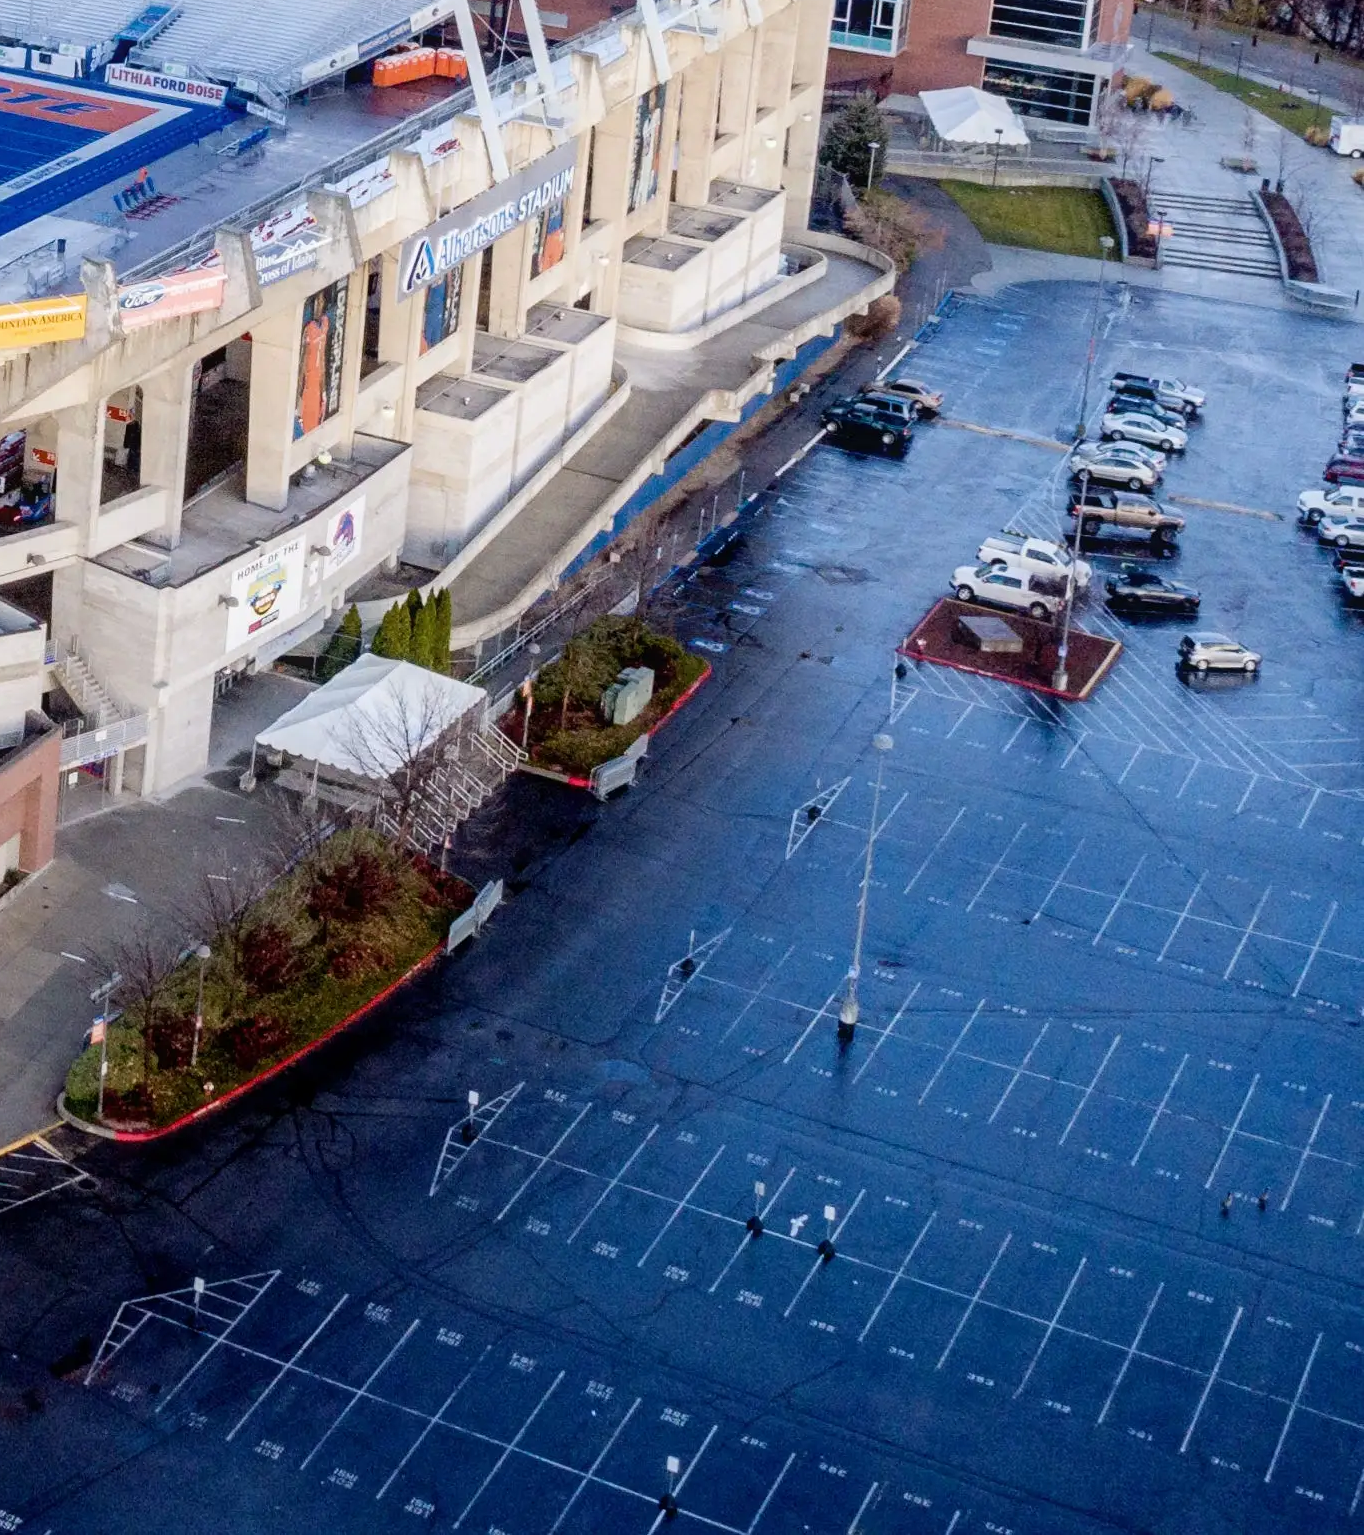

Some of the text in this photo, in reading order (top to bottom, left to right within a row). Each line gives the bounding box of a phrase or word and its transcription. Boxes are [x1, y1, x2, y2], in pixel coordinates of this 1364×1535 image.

[434, 166, 575, 271] Albertsons STADIUM
[255, 252, 278, 271] Blue
[281, 262, 291, 276] of
[292, 252, 317, 274] Idaho
[124, 286, 158, 309] Ford
[40, 312, 83, 327] AMERICA
[237, 560, 263, 581] HOME
[268, 553, 280, 565] OF
[283, 542, 300, 558] THE
